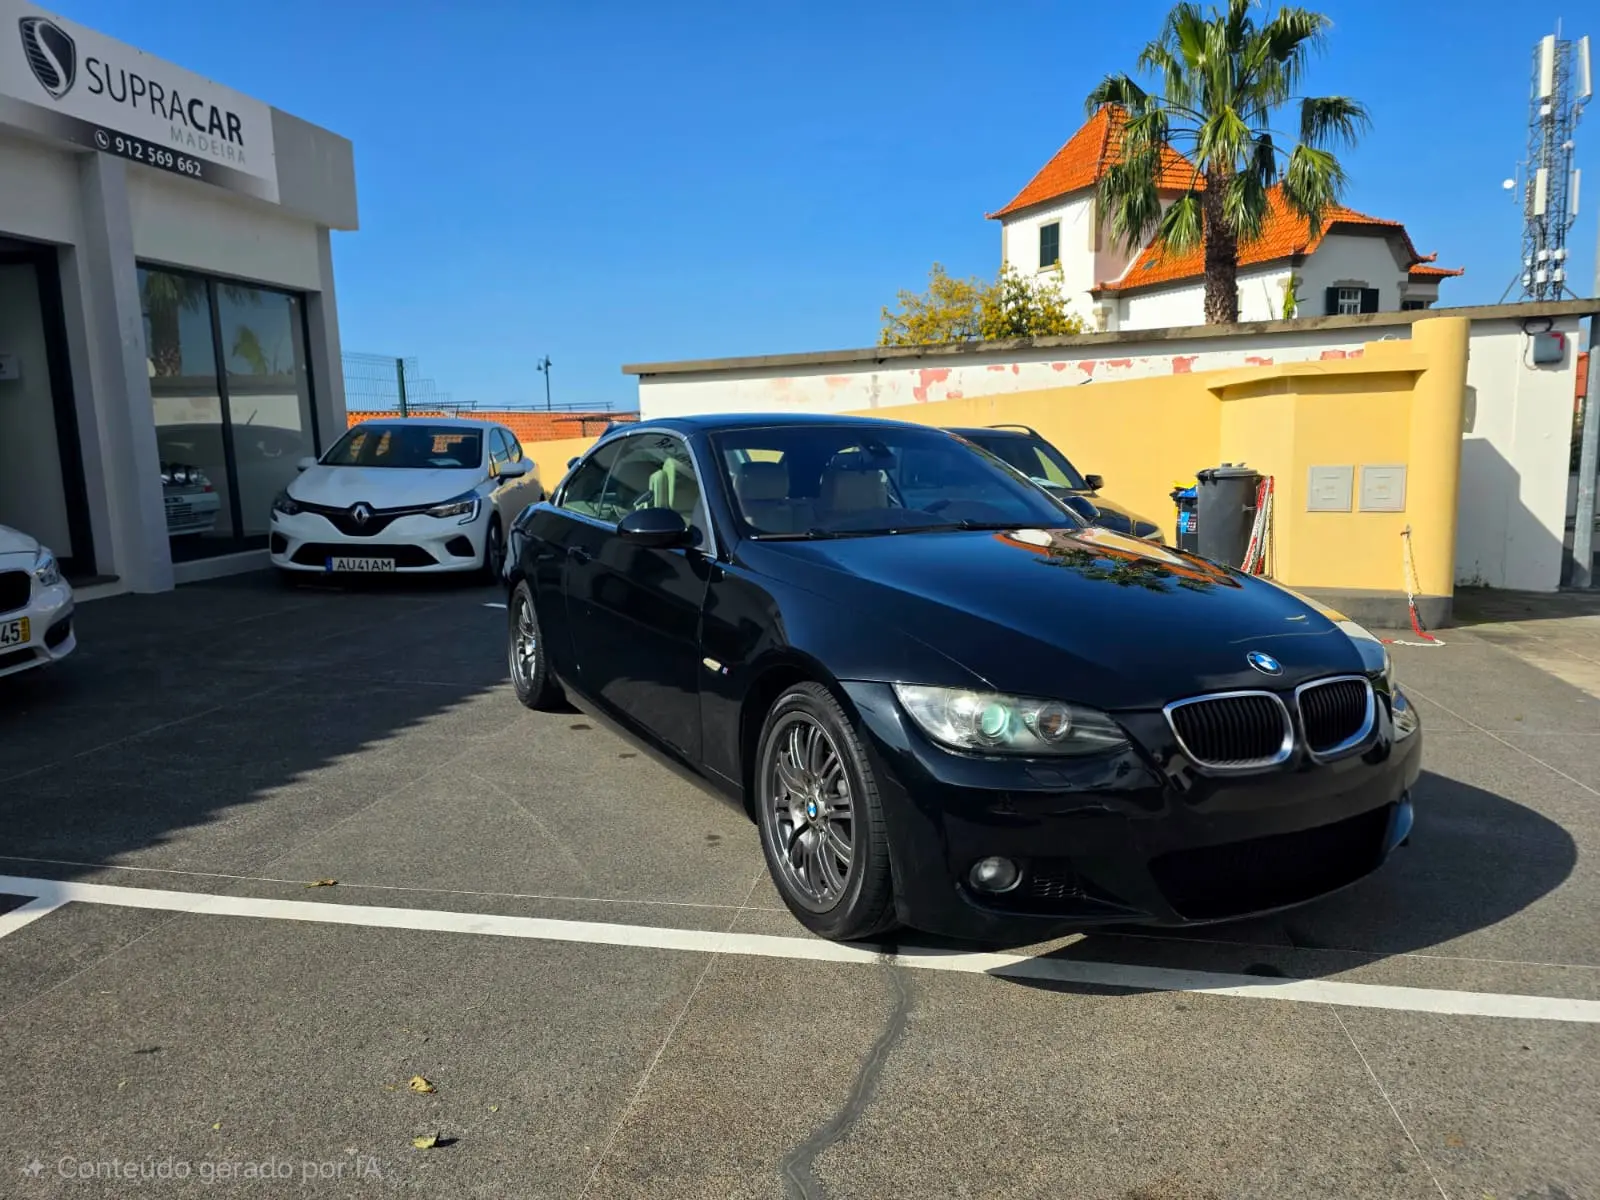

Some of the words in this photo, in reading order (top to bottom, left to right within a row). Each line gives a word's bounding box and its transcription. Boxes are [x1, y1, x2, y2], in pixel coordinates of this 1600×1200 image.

[85, 57, 244, 146] SUPRACAR
[115, 137, 143, 159] 912
[148, 147, 173, 167] 569
[177, 157, 202, 176] 662
[170, 126, 246, 164] MADEIRA
